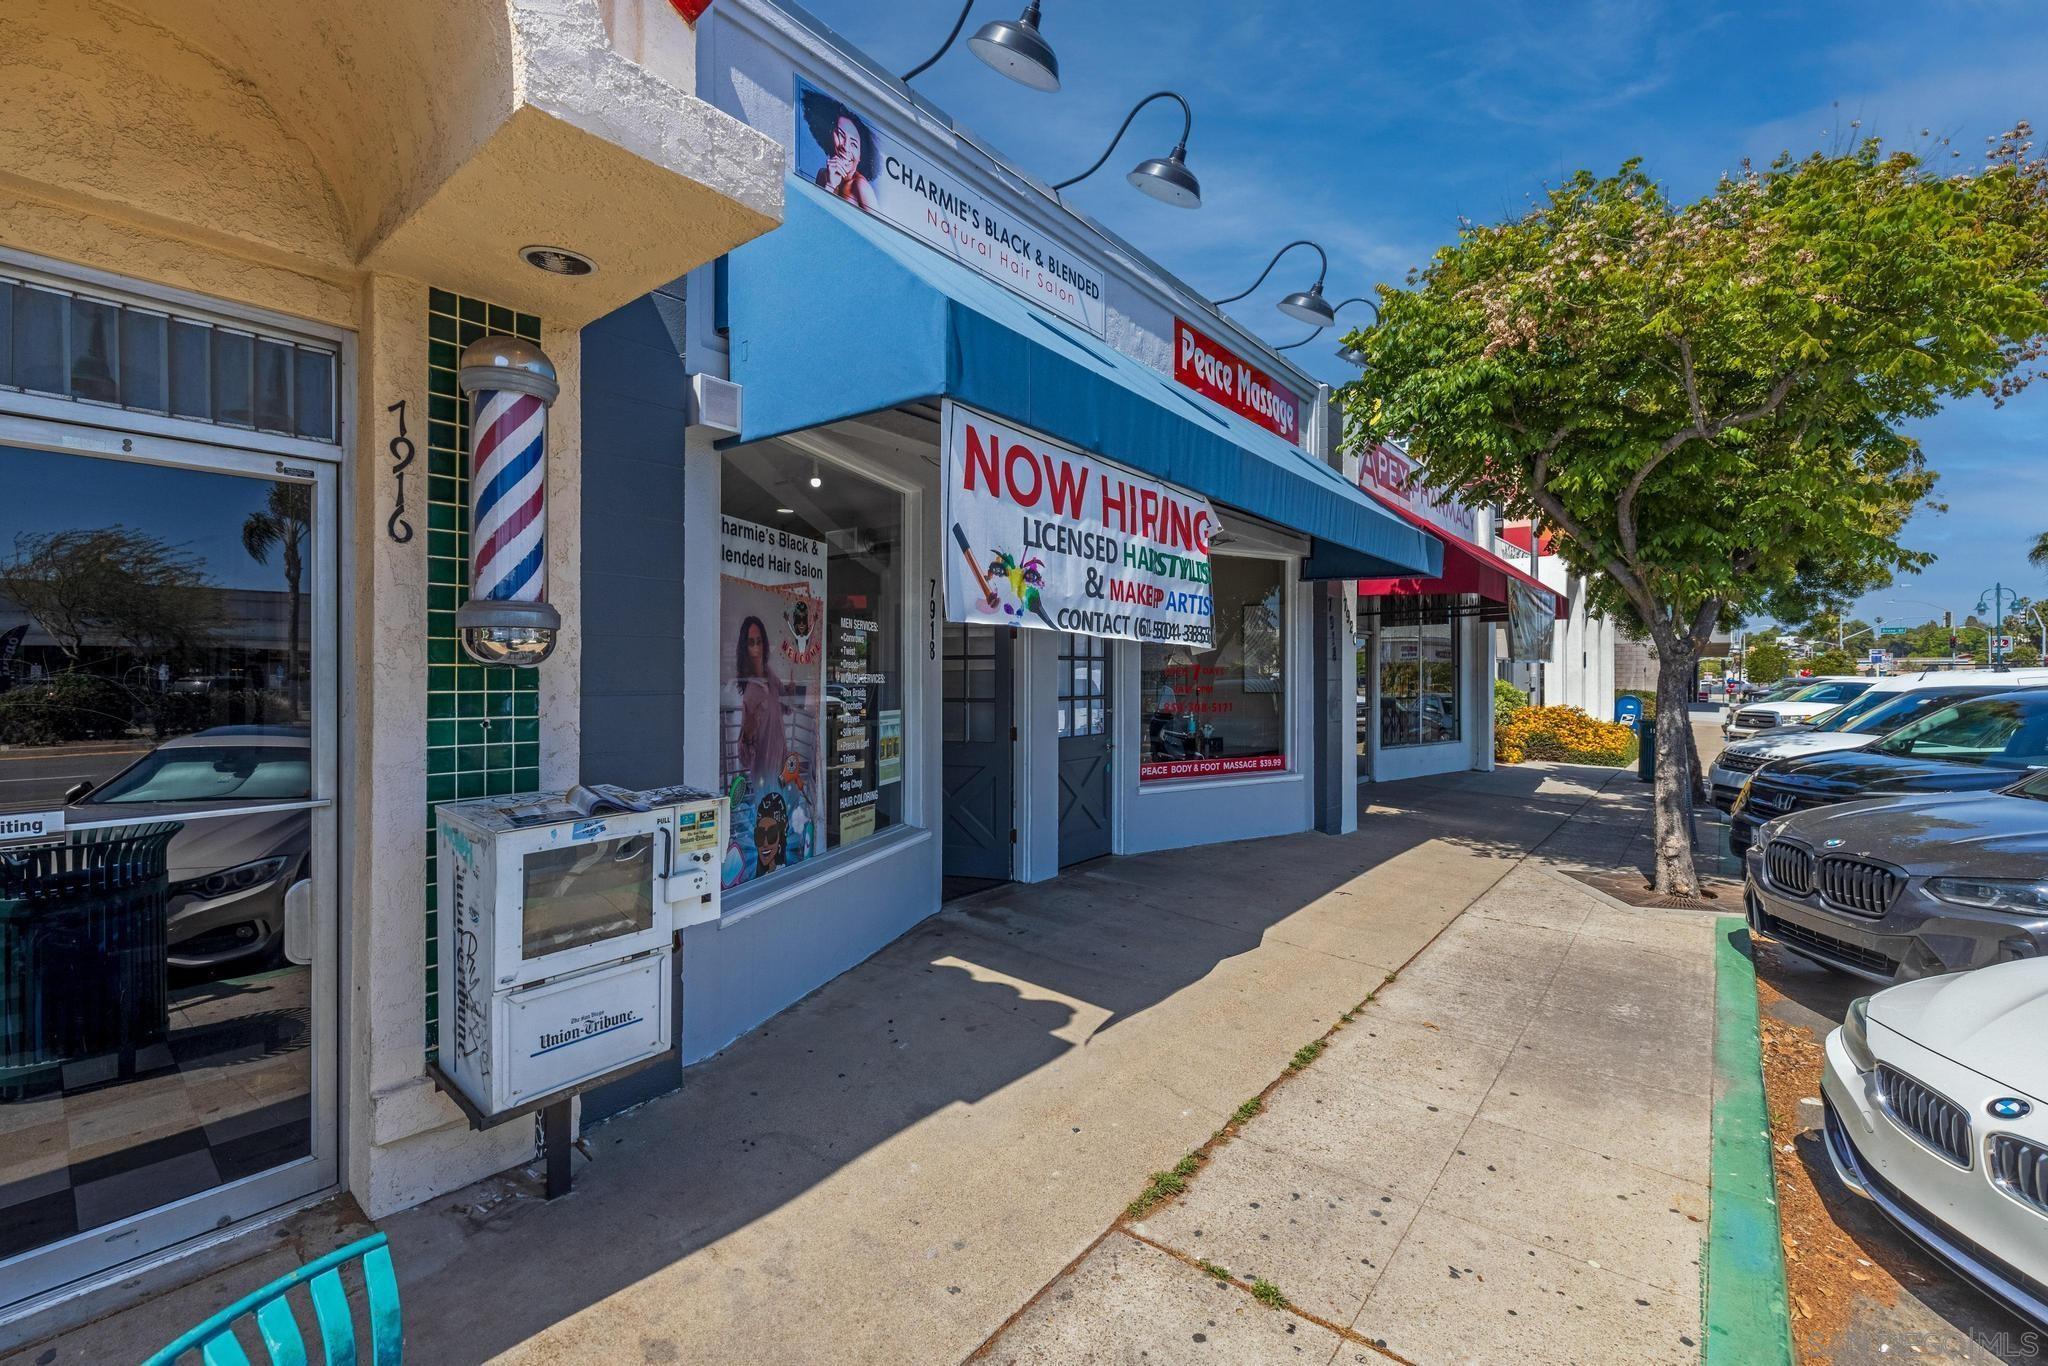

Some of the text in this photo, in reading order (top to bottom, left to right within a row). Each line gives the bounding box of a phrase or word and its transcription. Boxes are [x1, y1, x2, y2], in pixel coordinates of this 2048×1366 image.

[886, 156, 1100, 299] CHARMIE'S BLACK & BLENDED
[927, 208, 1075, 305] Natural Hair Salon
[1182, 327, 1294, 434] Peace Massage
[388, 400, 415, 543] 7916
[1360, 447, 1409, 490] APEX
[963, 423, 1211, 556] NOW HIRING
[722, 516, 818, 556] harmie's Black &
[1023, 516, 1118, 564] LICENSED
[721, 544, 823, 579] lended Hair Salon
[1086, 566, 1105, 600] &
[1165, 590, 1213, 616] ARTIS
[840, 617, 879, 632] MEN SERVICES:
[1057, 607, 1130, 635] CONTACT
[843, 646, 856, 656] Twist
[1190, 664, 1201, 681] 7
[1141, 758, 1282, 776] PEACE BODY & FOOT MASSAGE $39.99
[840, 789, 879, 809] HAIR COLORING
[0, 819, 43, 834] iting
[657, 817, 671, 825] PULL
